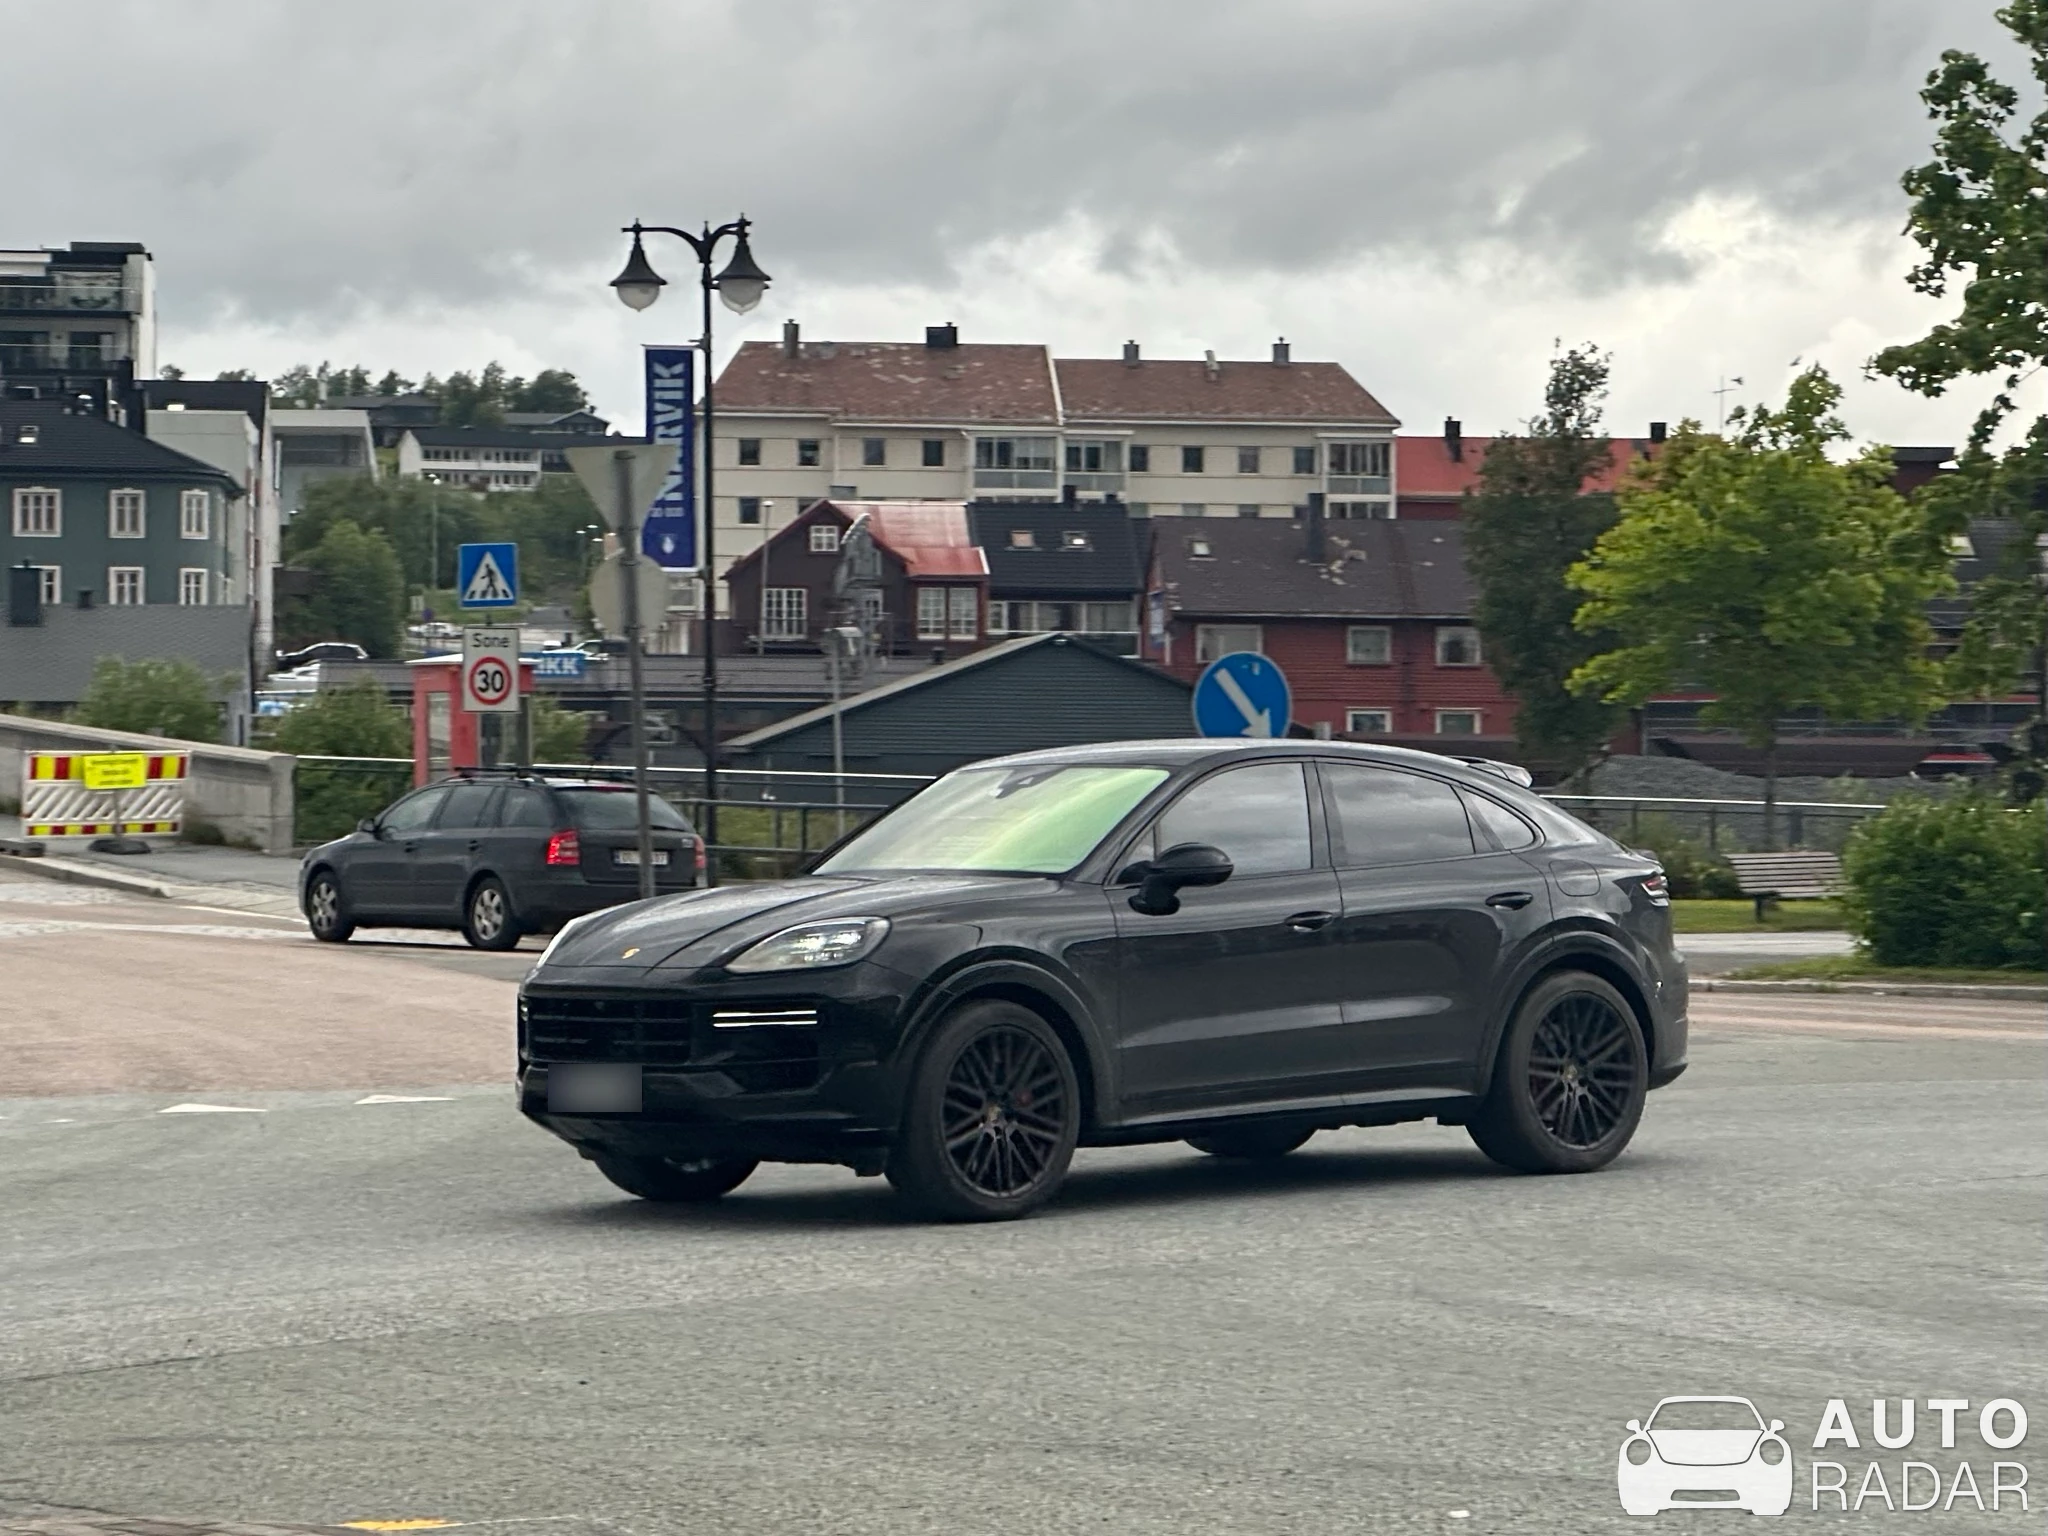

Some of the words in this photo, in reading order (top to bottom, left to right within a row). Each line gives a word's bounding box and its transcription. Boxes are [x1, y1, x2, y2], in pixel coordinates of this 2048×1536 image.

[653, 363, 684, 501] NRVIK
[472, 632, 510, 648] Sone
[478, 669, 504, 693] 30
